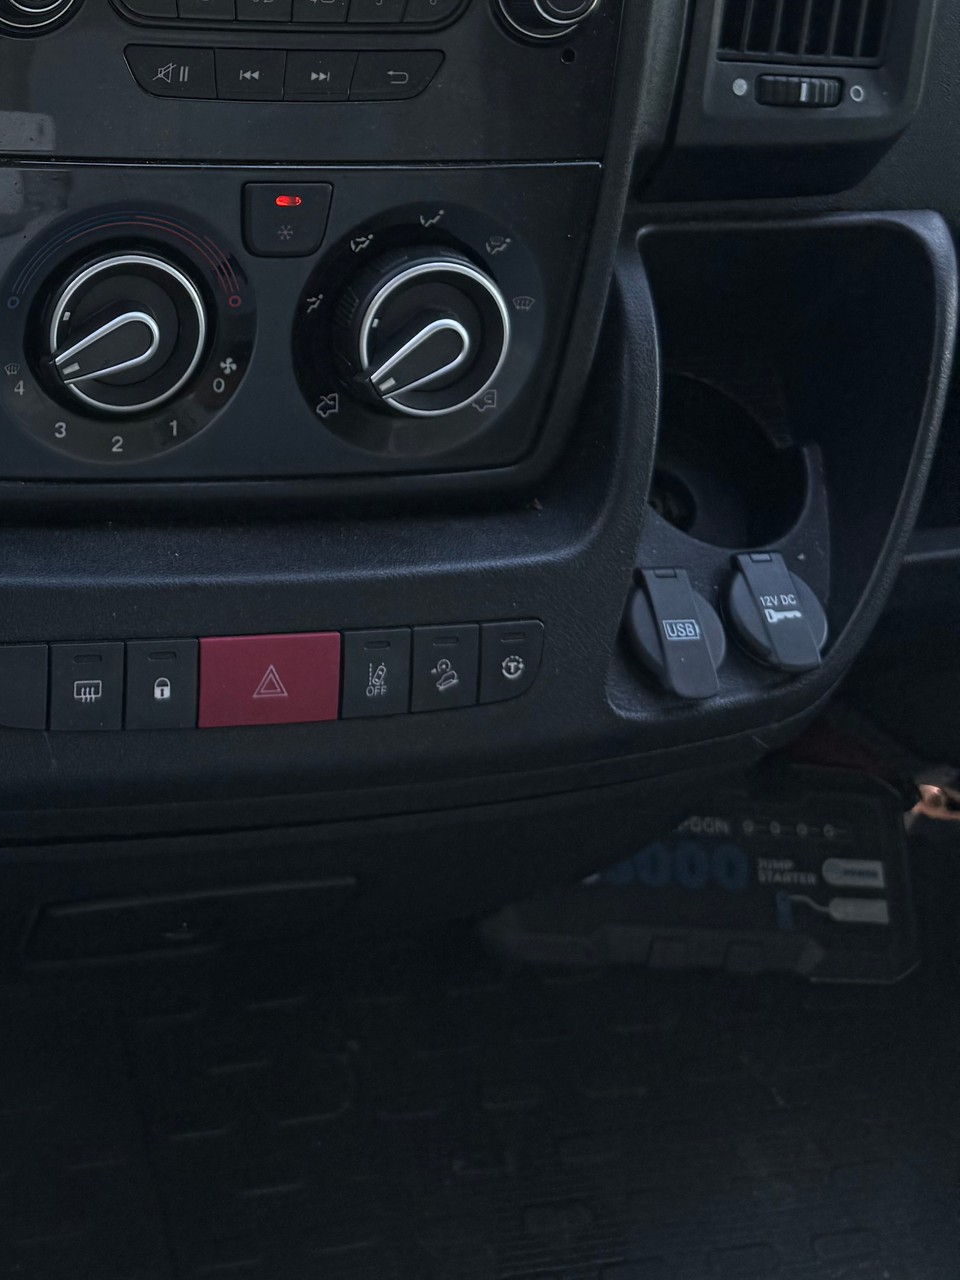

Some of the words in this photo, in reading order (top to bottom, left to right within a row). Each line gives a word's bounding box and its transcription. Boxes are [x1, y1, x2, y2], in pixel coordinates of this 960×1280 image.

[13, 379, 26, 396] 4
[212, 377, 226, 394] 0
[53, 421, 67, 439] 3
[168, 419, 179, 437] 1
[110, 435, 124, 453] 2
[759, 594, 778, 607] 12V
[780, 593, 798, 606] DC
[665, 622, 697, 638] USB
[365, 685, 388, 698] OFF
[757, 870, 818, 886] STARTER
